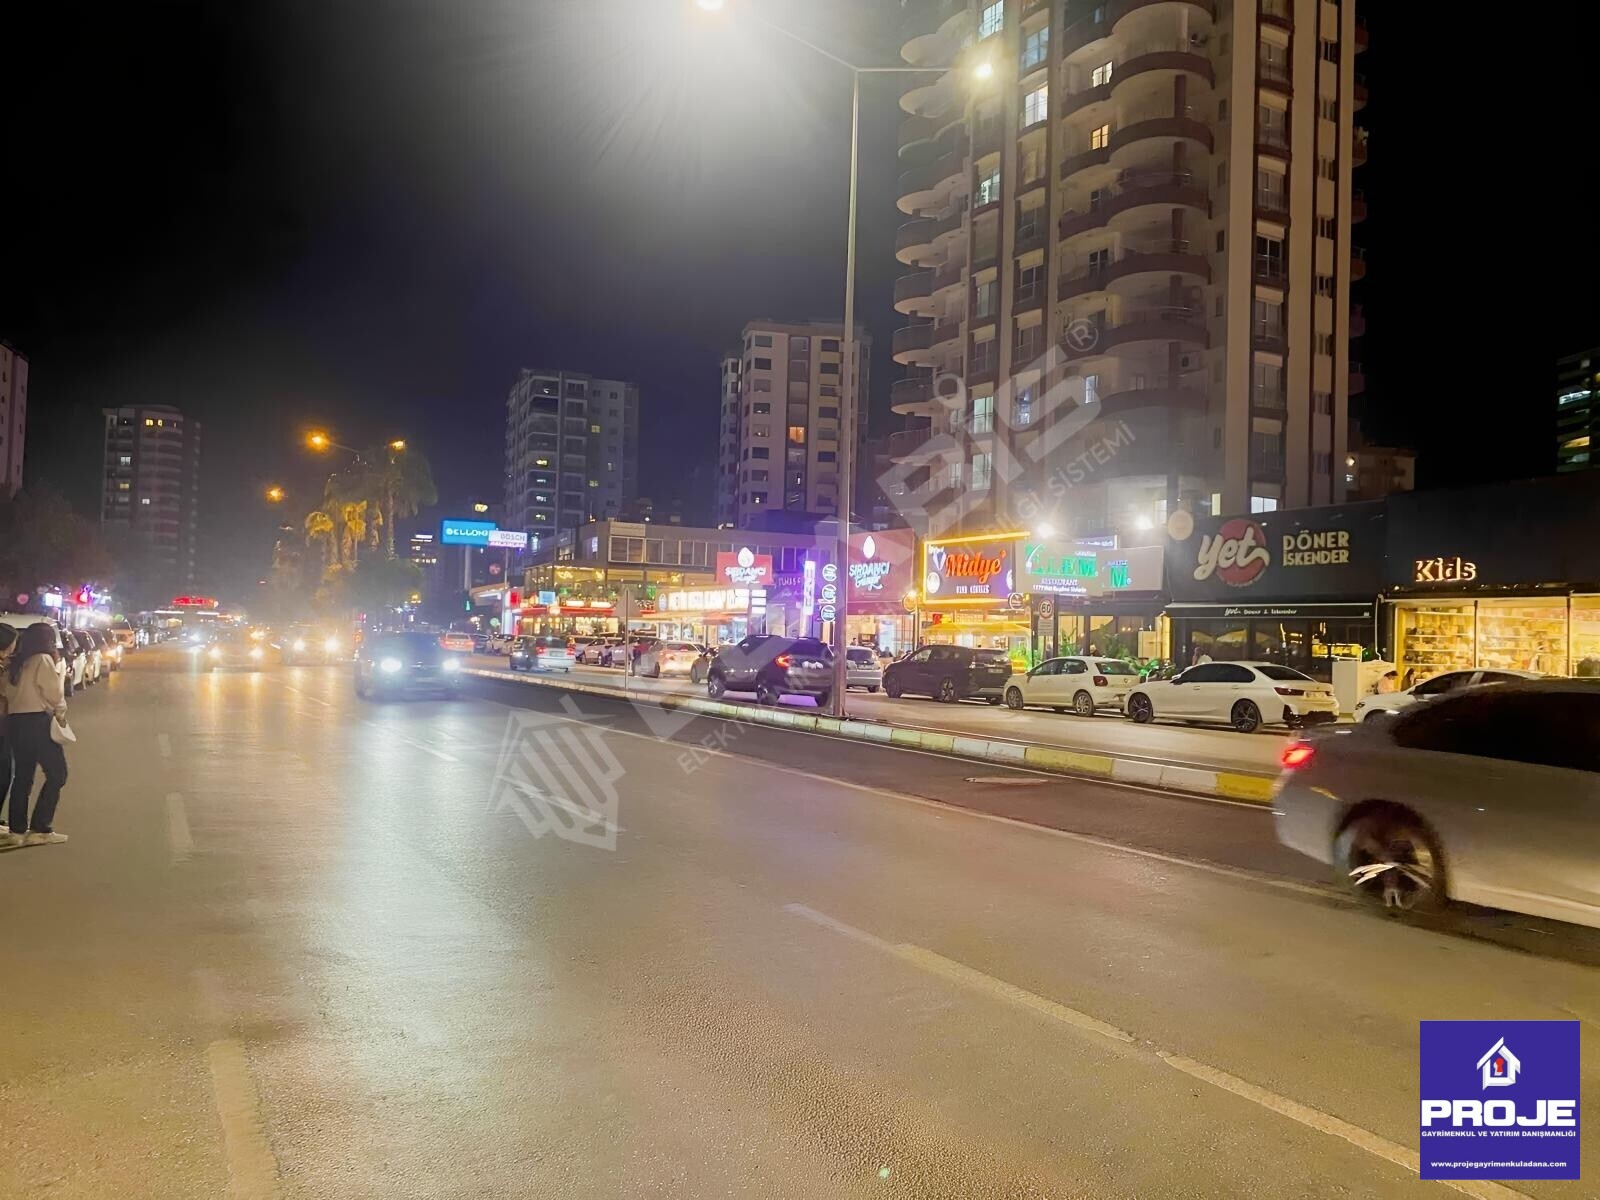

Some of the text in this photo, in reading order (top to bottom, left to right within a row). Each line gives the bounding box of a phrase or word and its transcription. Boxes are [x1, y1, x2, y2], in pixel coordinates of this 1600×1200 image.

[500, 532, 526, 542] BOSCH
[1282, 529, 1350, 550] DÖNER
[1193, 526, 1271, 581] yet
[1282, 547, 1350, 567] İSKENDER
[1415, 556, 1477, 582] Kids
